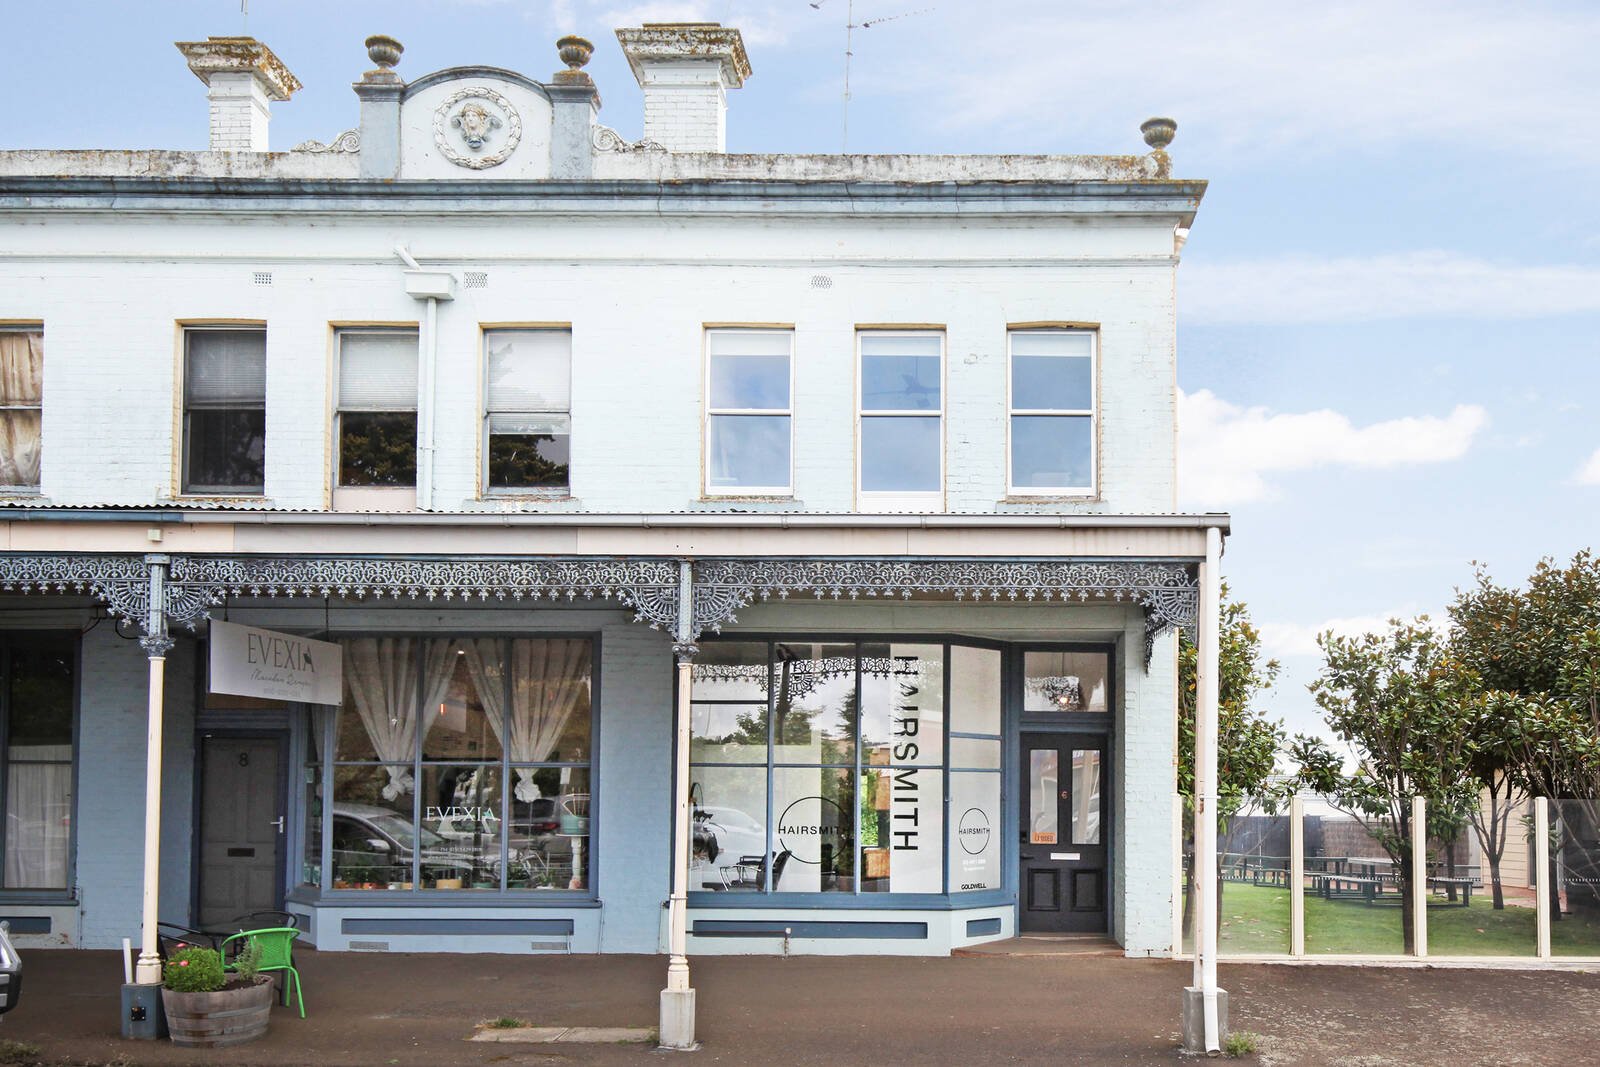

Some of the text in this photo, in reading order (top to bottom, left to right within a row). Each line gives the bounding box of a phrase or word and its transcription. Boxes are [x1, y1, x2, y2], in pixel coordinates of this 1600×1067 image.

[248, 633, 314, 672] EVEXIA
[238, 752, 249, 767] 8
[893, 656, 919, 850] HAIRSMITH
[425, 806, 496, 821] EVEXIA
[778, 825, 849, 835] HAIRSMIT
[958, 827, 991, 836] HAIRSMITH
